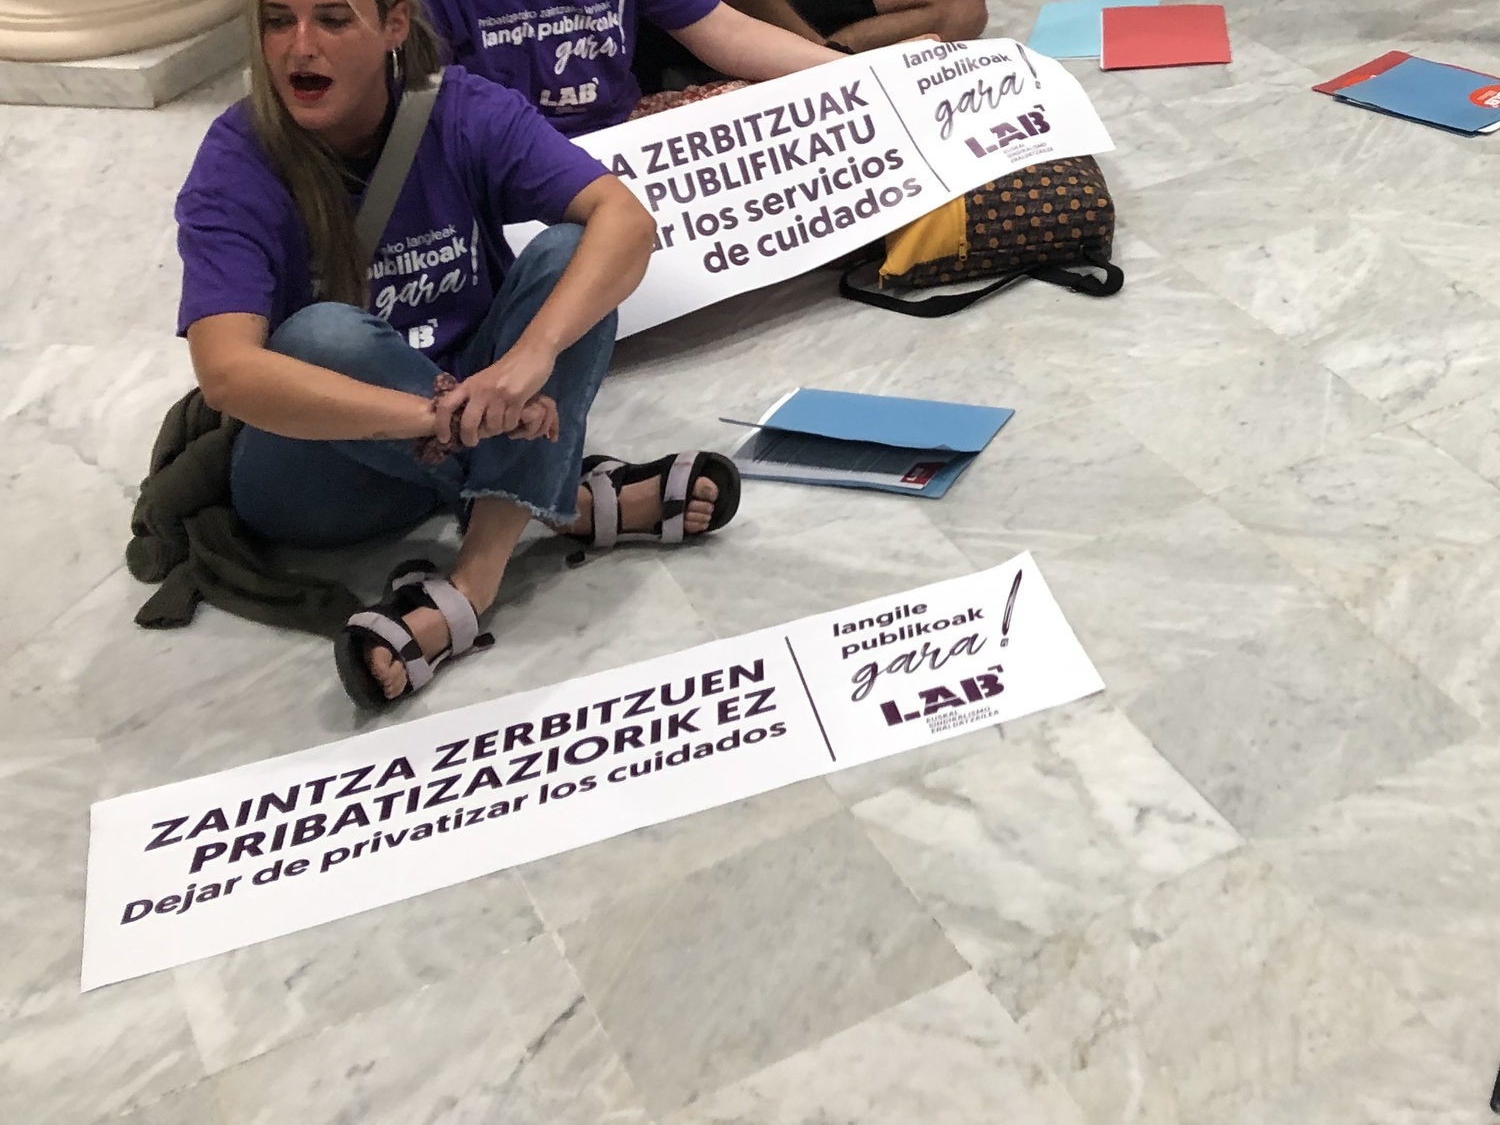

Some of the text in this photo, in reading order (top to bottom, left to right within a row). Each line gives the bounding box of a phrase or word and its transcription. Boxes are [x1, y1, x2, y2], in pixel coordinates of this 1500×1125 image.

[539, 77, 600, 107] LAB
[916, 52, 1012, 94] publikoak
[641, 80, 870, 175] ZERBITZUAK
[644, 114, 877, 213] PUBLIFIKATU
[963, 105, 1052, 159] LAB
[681, 200, 744, 241] los
[744, 147, 904, 224] servicios
[703, 177, 923, 274] de cuidados
[833, 602, 928, 637] langile
[841, 607, 985, 659] publikoak
[880, 664, 1005, 727] LAB
[144, 657, 767, 853] ZAINTZA ZERBITZUEN
[188, 686, 778, 874] PRIBATIZAZIORIK EZ
[120, 719, 788, 926] Dejar de privatizar los cuidados
